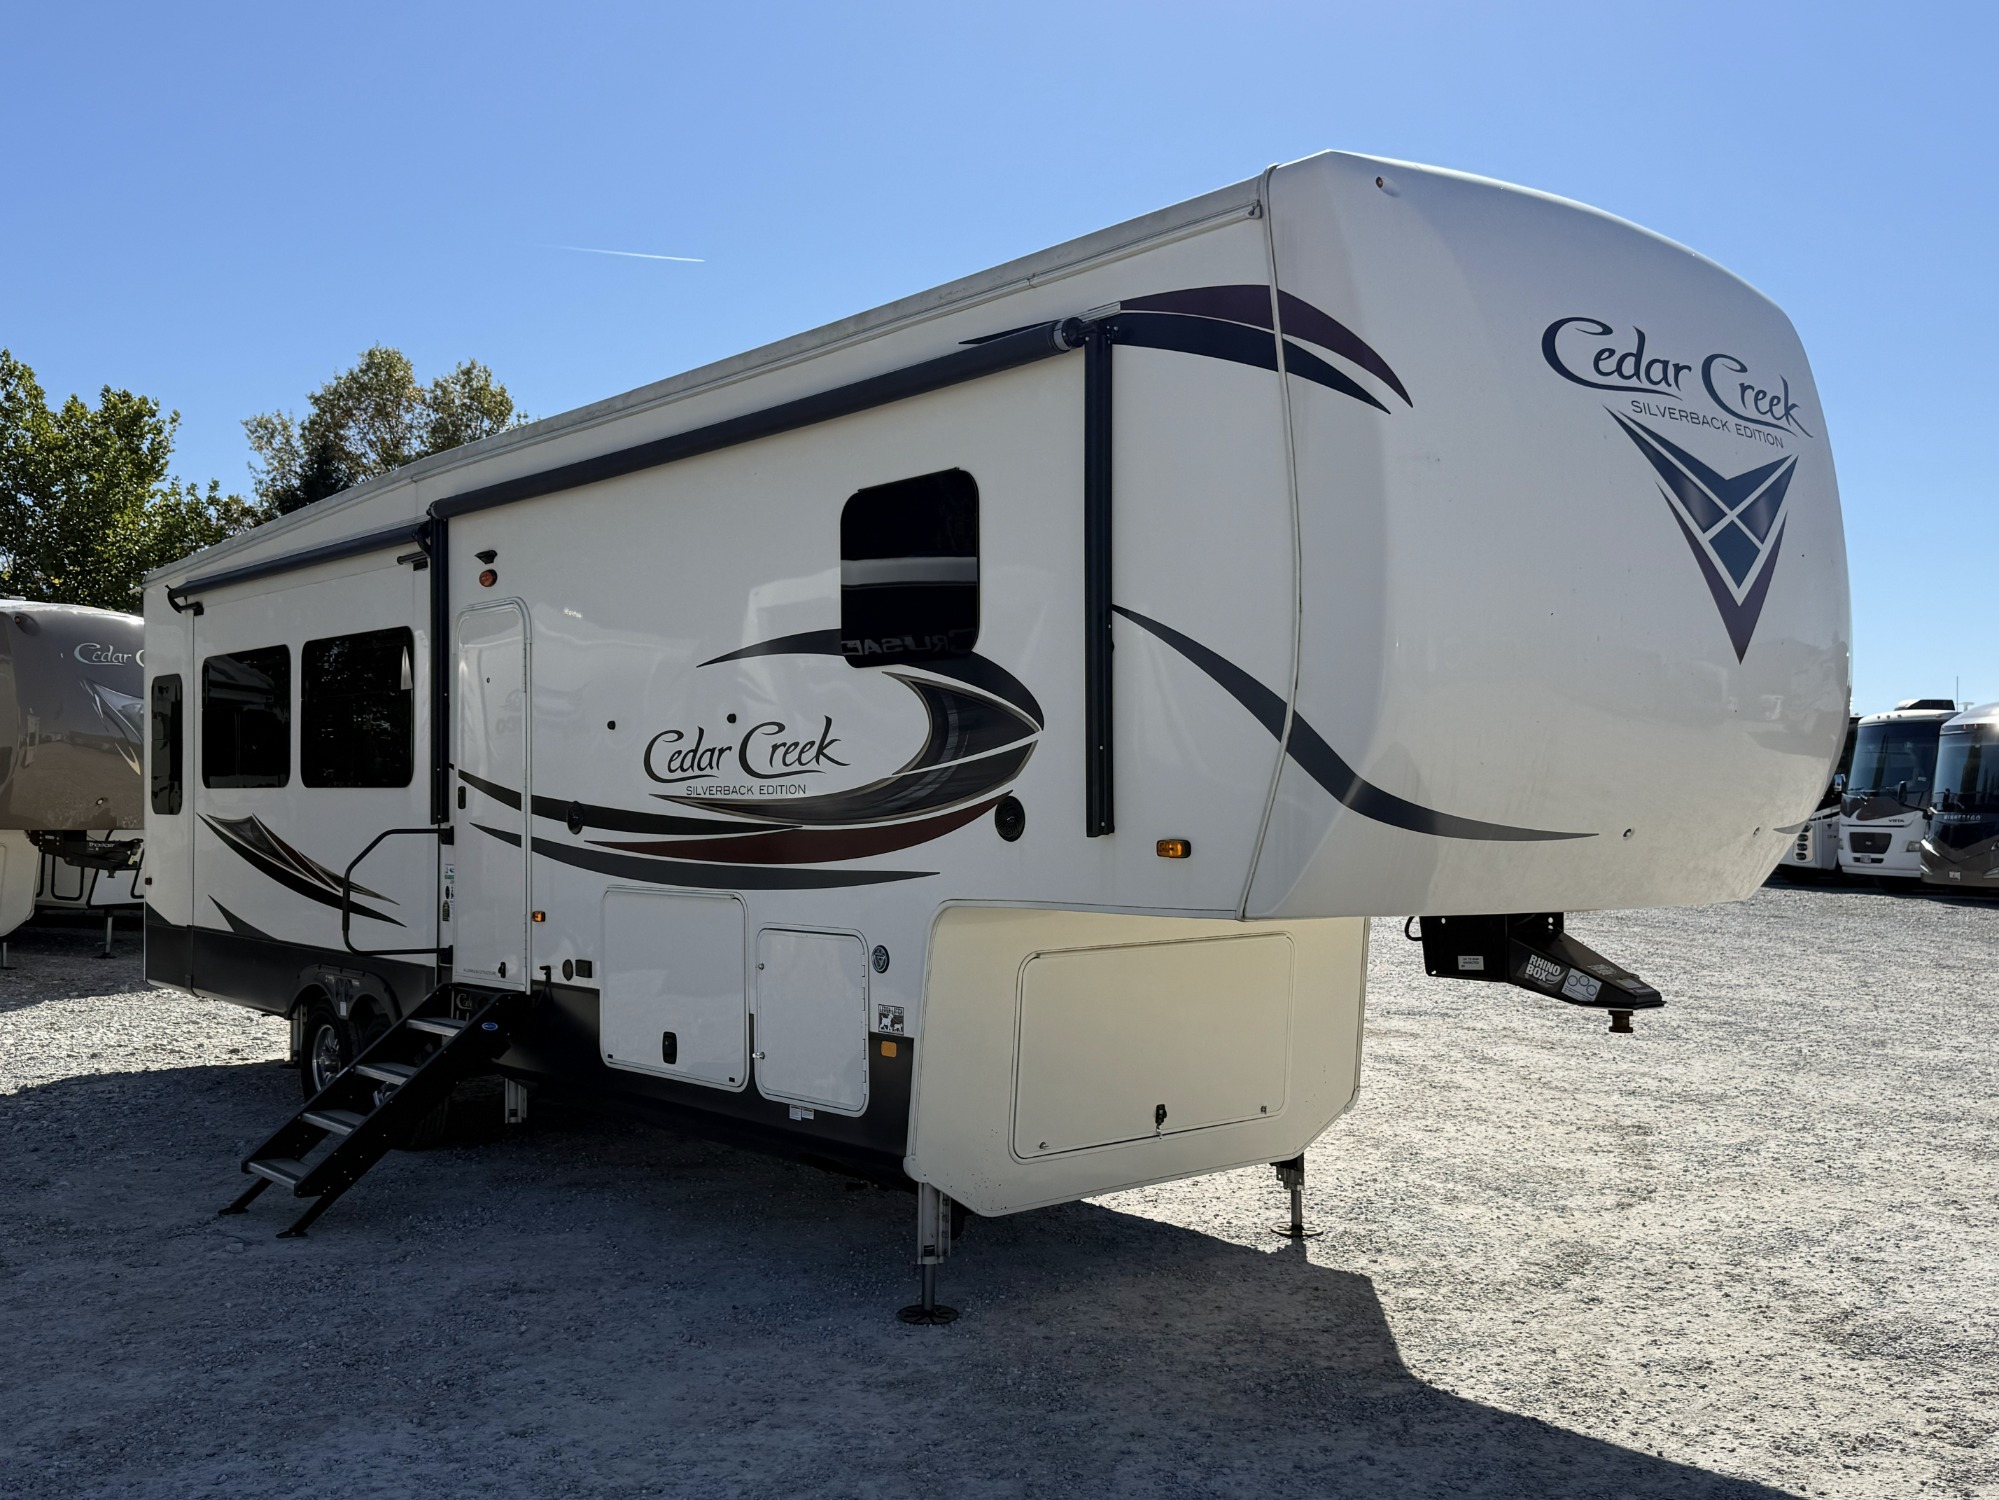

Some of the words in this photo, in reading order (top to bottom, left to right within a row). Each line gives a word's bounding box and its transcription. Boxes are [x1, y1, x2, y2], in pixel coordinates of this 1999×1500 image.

[1541, 316, 1692, 400] Cedar
[1701, 353, 1813, 438] Creek
[1631, 400, 1731, 433] SILVERBACK
[1735, 423, 1784, 449] EDITION
[74, 642, 132, 666] Cedar
[643, 726, 733, 783] Cedar
[738, 715, 851, 779] Creek
[686, 785, 754, 796] SILVERBACK
[759, 784, 806, 795] EDITION
[1525, 964, 1549, 981] BOX
[1528, 954, 1561, 976] RHINO
